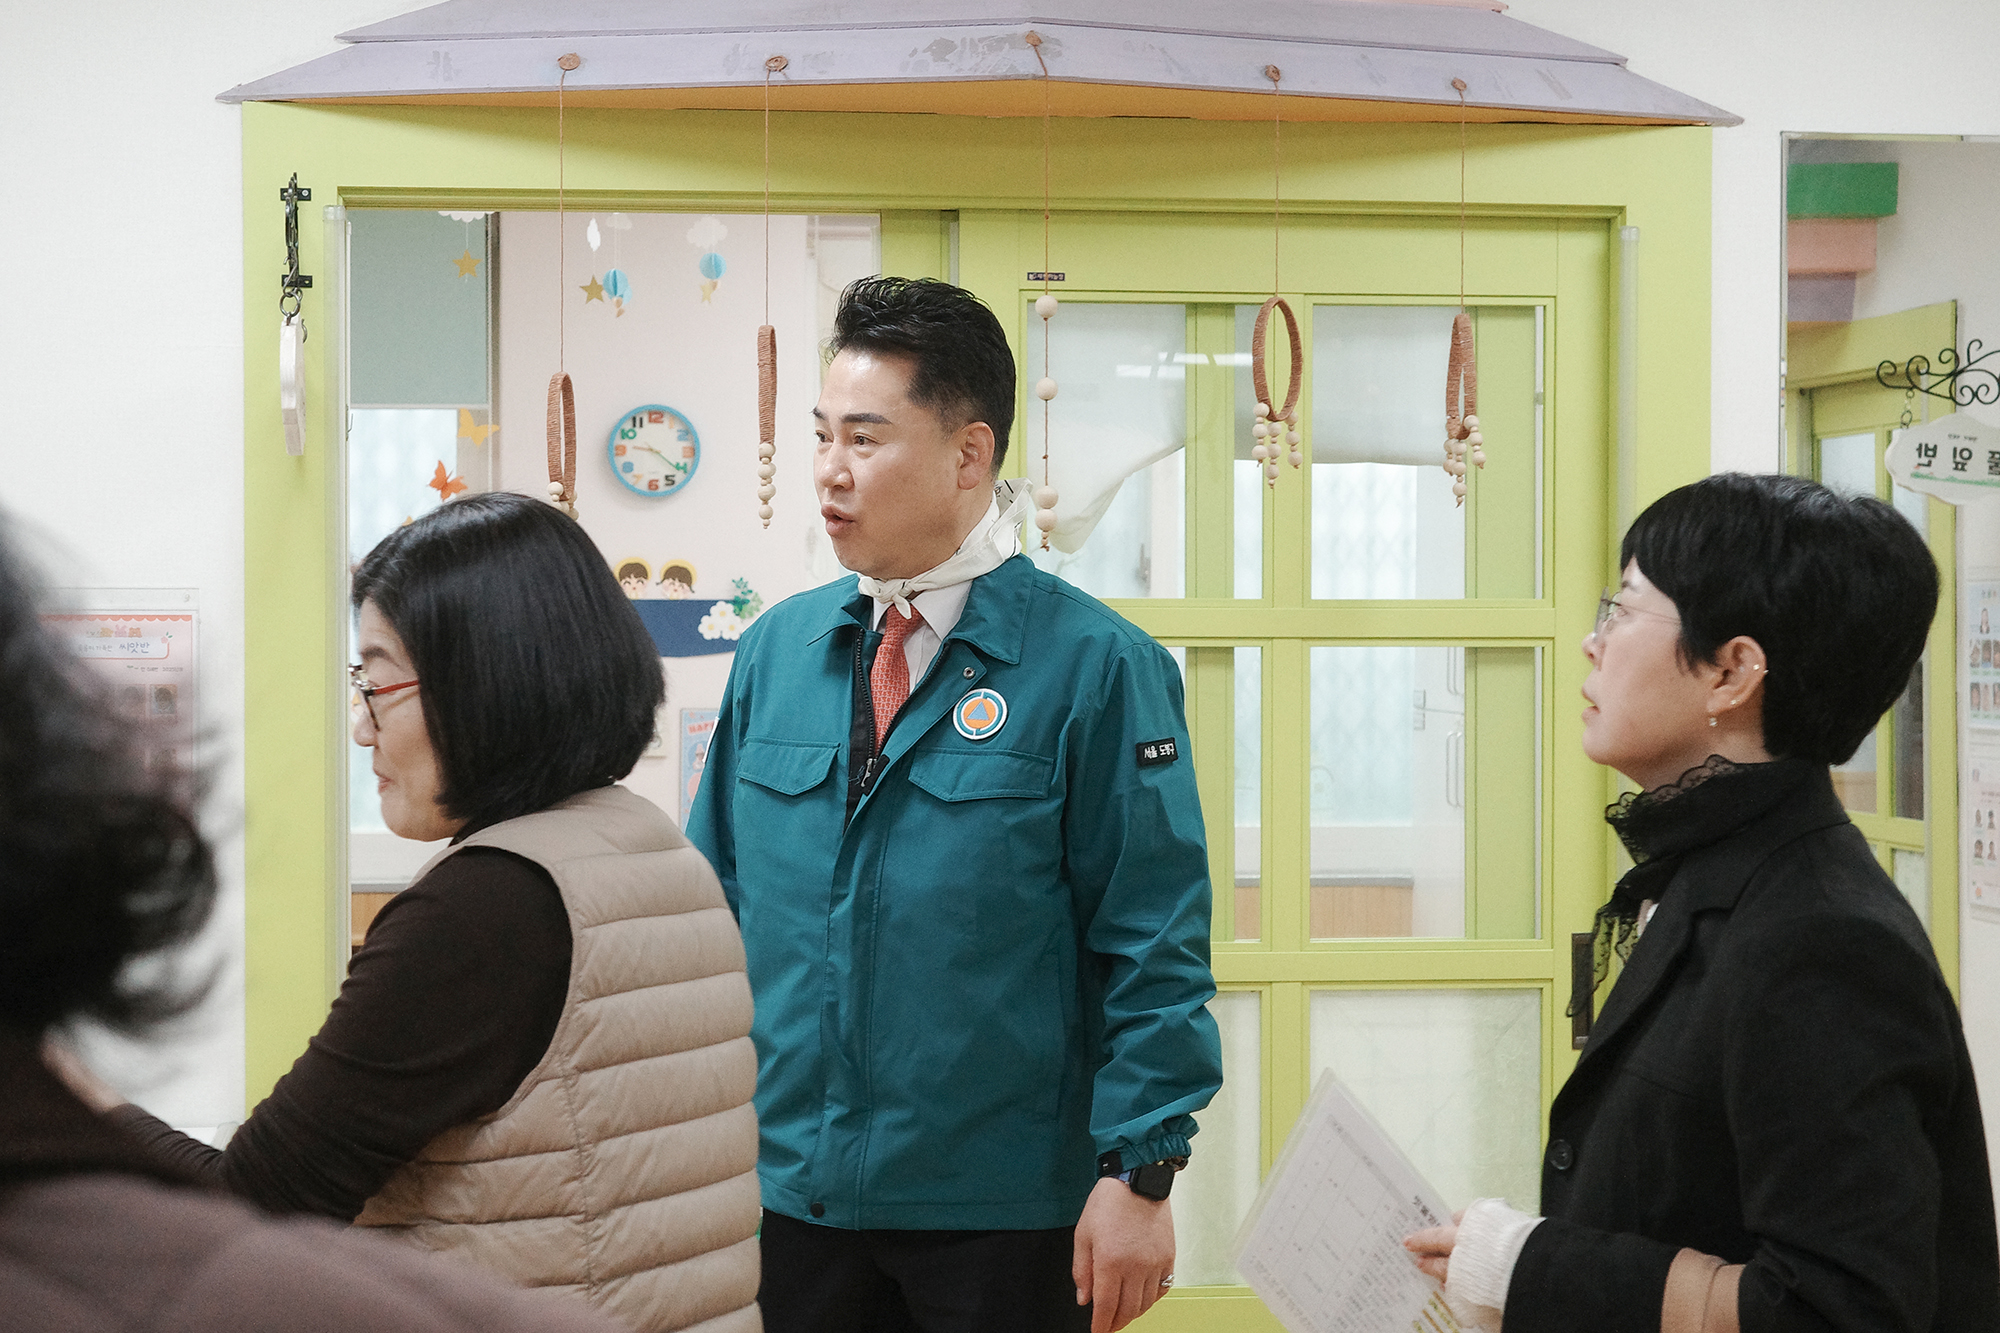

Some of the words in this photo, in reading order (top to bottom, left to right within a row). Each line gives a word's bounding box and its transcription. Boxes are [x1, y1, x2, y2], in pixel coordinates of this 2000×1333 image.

[632, 416, 643, 428] 11
[648, 410, 664, 424] 12
[621, 428, 637, 440] 10
[647, 479, 659, 491] 6
[664, 474, 676, 486] 5
[119, 642, 150, 654] 씨앗반
[1144, 745, 1158, 759] 서울
[1159, 743, 1175, 756] 도봉구
